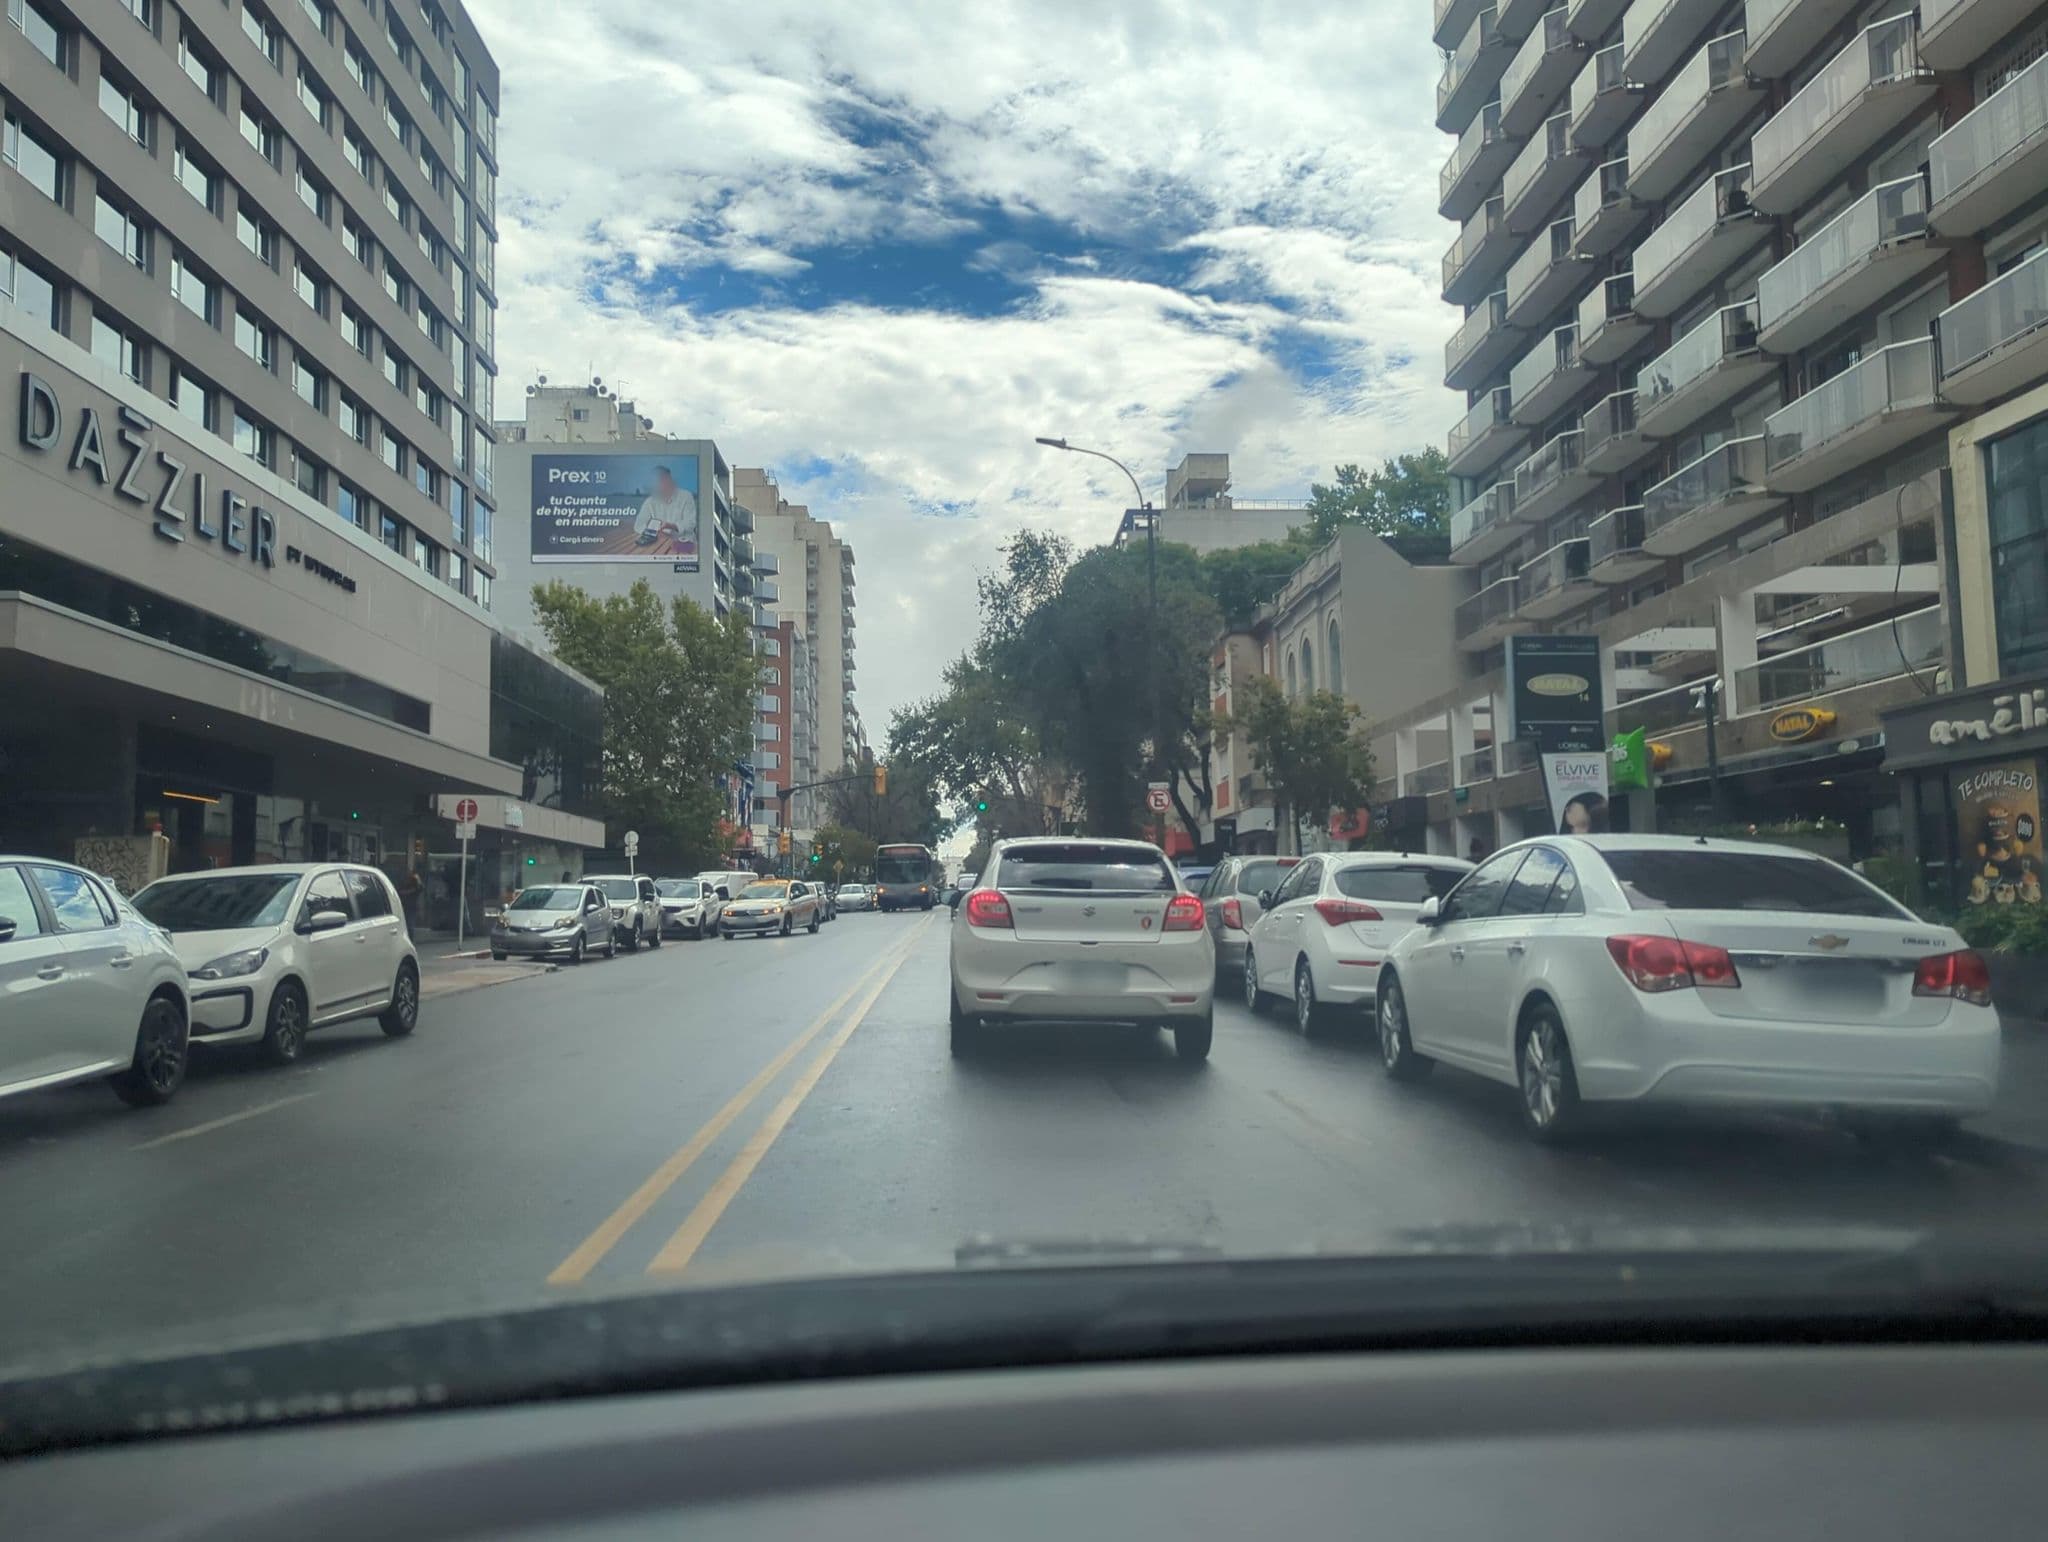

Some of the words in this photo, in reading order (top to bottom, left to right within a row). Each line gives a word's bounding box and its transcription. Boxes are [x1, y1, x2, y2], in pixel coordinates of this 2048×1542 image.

[20, 372, 278, 569] DAZZLER
[549, 468, 591, 483] Prex
[550, 496, 563, 505] tu
[564, 496, 607, 505] Cuenta
[536, 506, 552, 516] de
[553, 506, 577, 518] hoy,
[579, 506, 637, 518] pensando
[555, 518, 571, 527] en
[572, 517, 621, 527] mañana
[1556, 764, 1600, 777] ELVIVE
[1958, 779, 1974, 801] TE
[1974, 769, 2034, 794] COMPLETO
